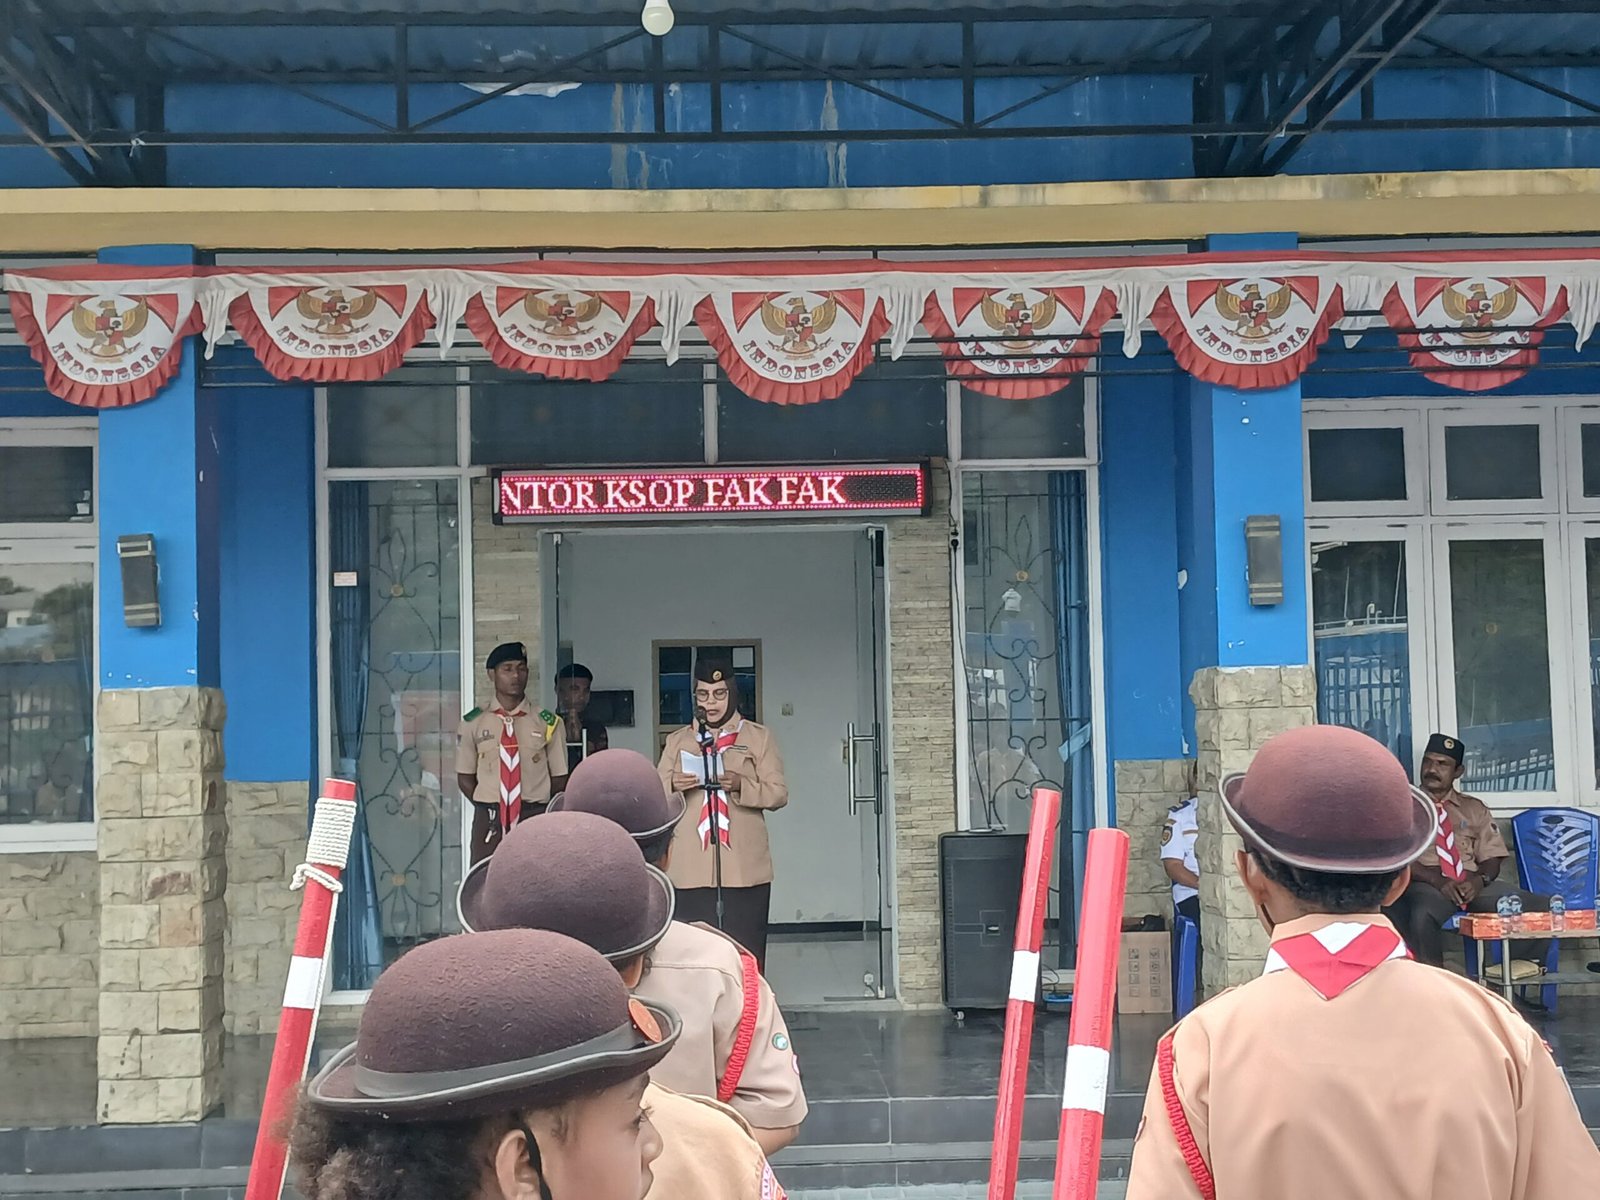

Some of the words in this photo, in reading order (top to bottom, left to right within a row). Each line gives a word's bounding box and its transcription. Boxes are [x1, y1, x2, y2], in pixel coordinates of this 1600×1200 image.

[276, 326, 394, 356] INDONESIA
[503, 323, 617, 357] INDONESIA
[964, 337, 1073, 374] NONESA
[1196, 324, 1309, 362] INDONESIA
[52, 342, 167, 382] INDONESIA
[743, 340, 856, 379] INDONESIA
[603, 479, 694, 508] KSOP
[703, 477, 773, 506] FAK
[776, 476, 846, 505] FAK
